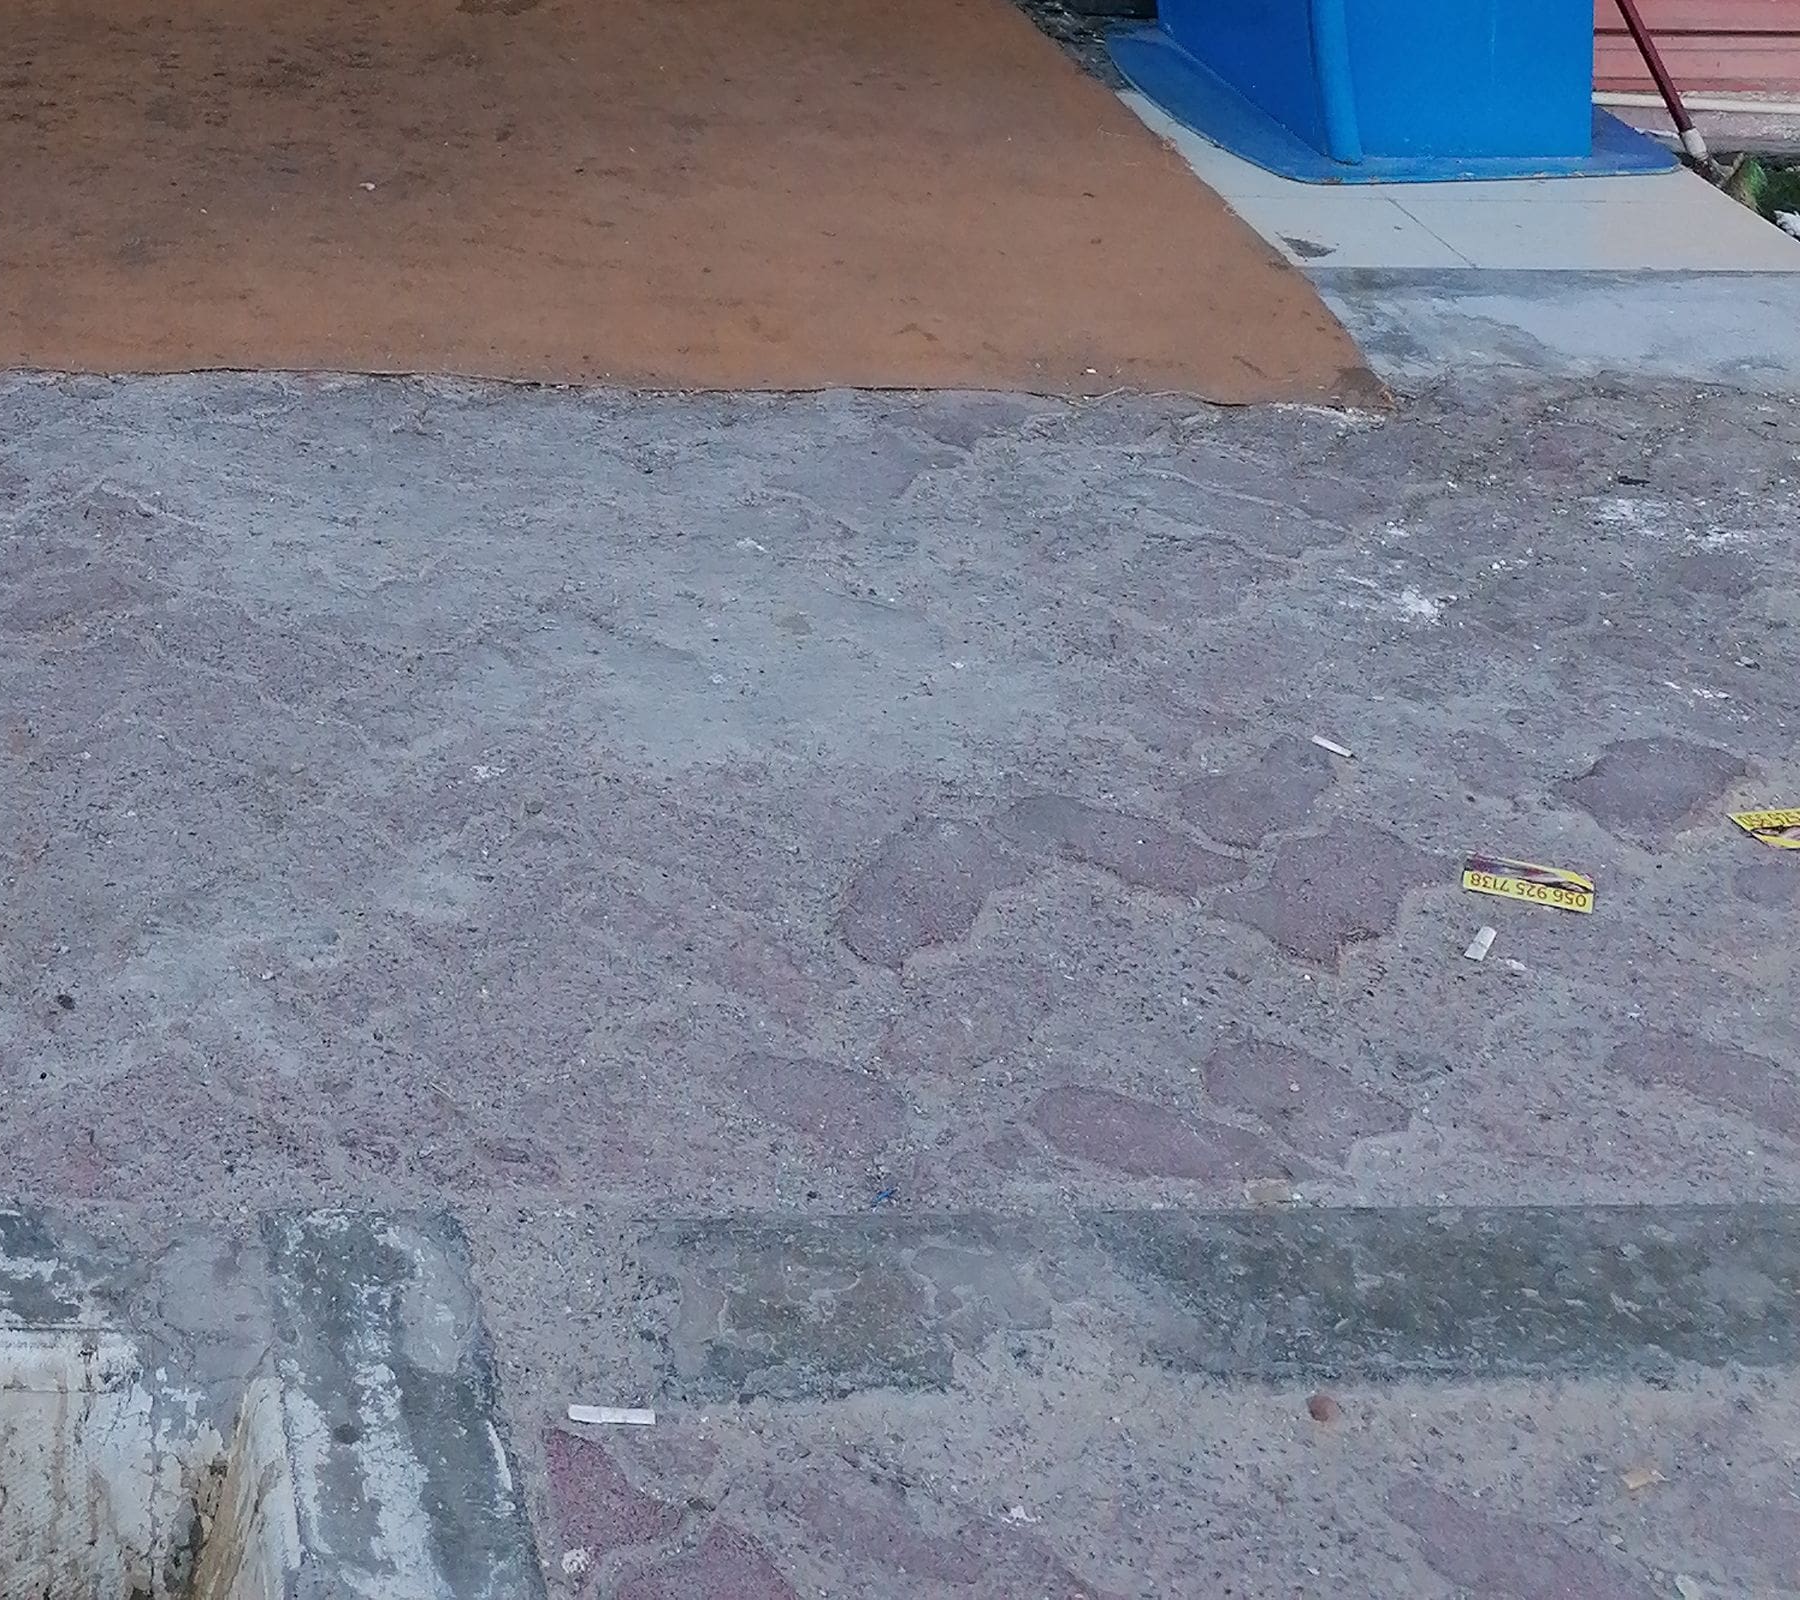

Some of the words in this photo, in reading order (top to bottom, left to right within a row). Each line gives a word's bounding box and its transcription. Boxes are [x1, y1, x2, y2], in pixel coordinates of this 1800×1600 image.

[1470, 872, 1510, 893] 7138
[1515, 881, 1548, 901] 925
[1552, 888, 1588, 908] 056
